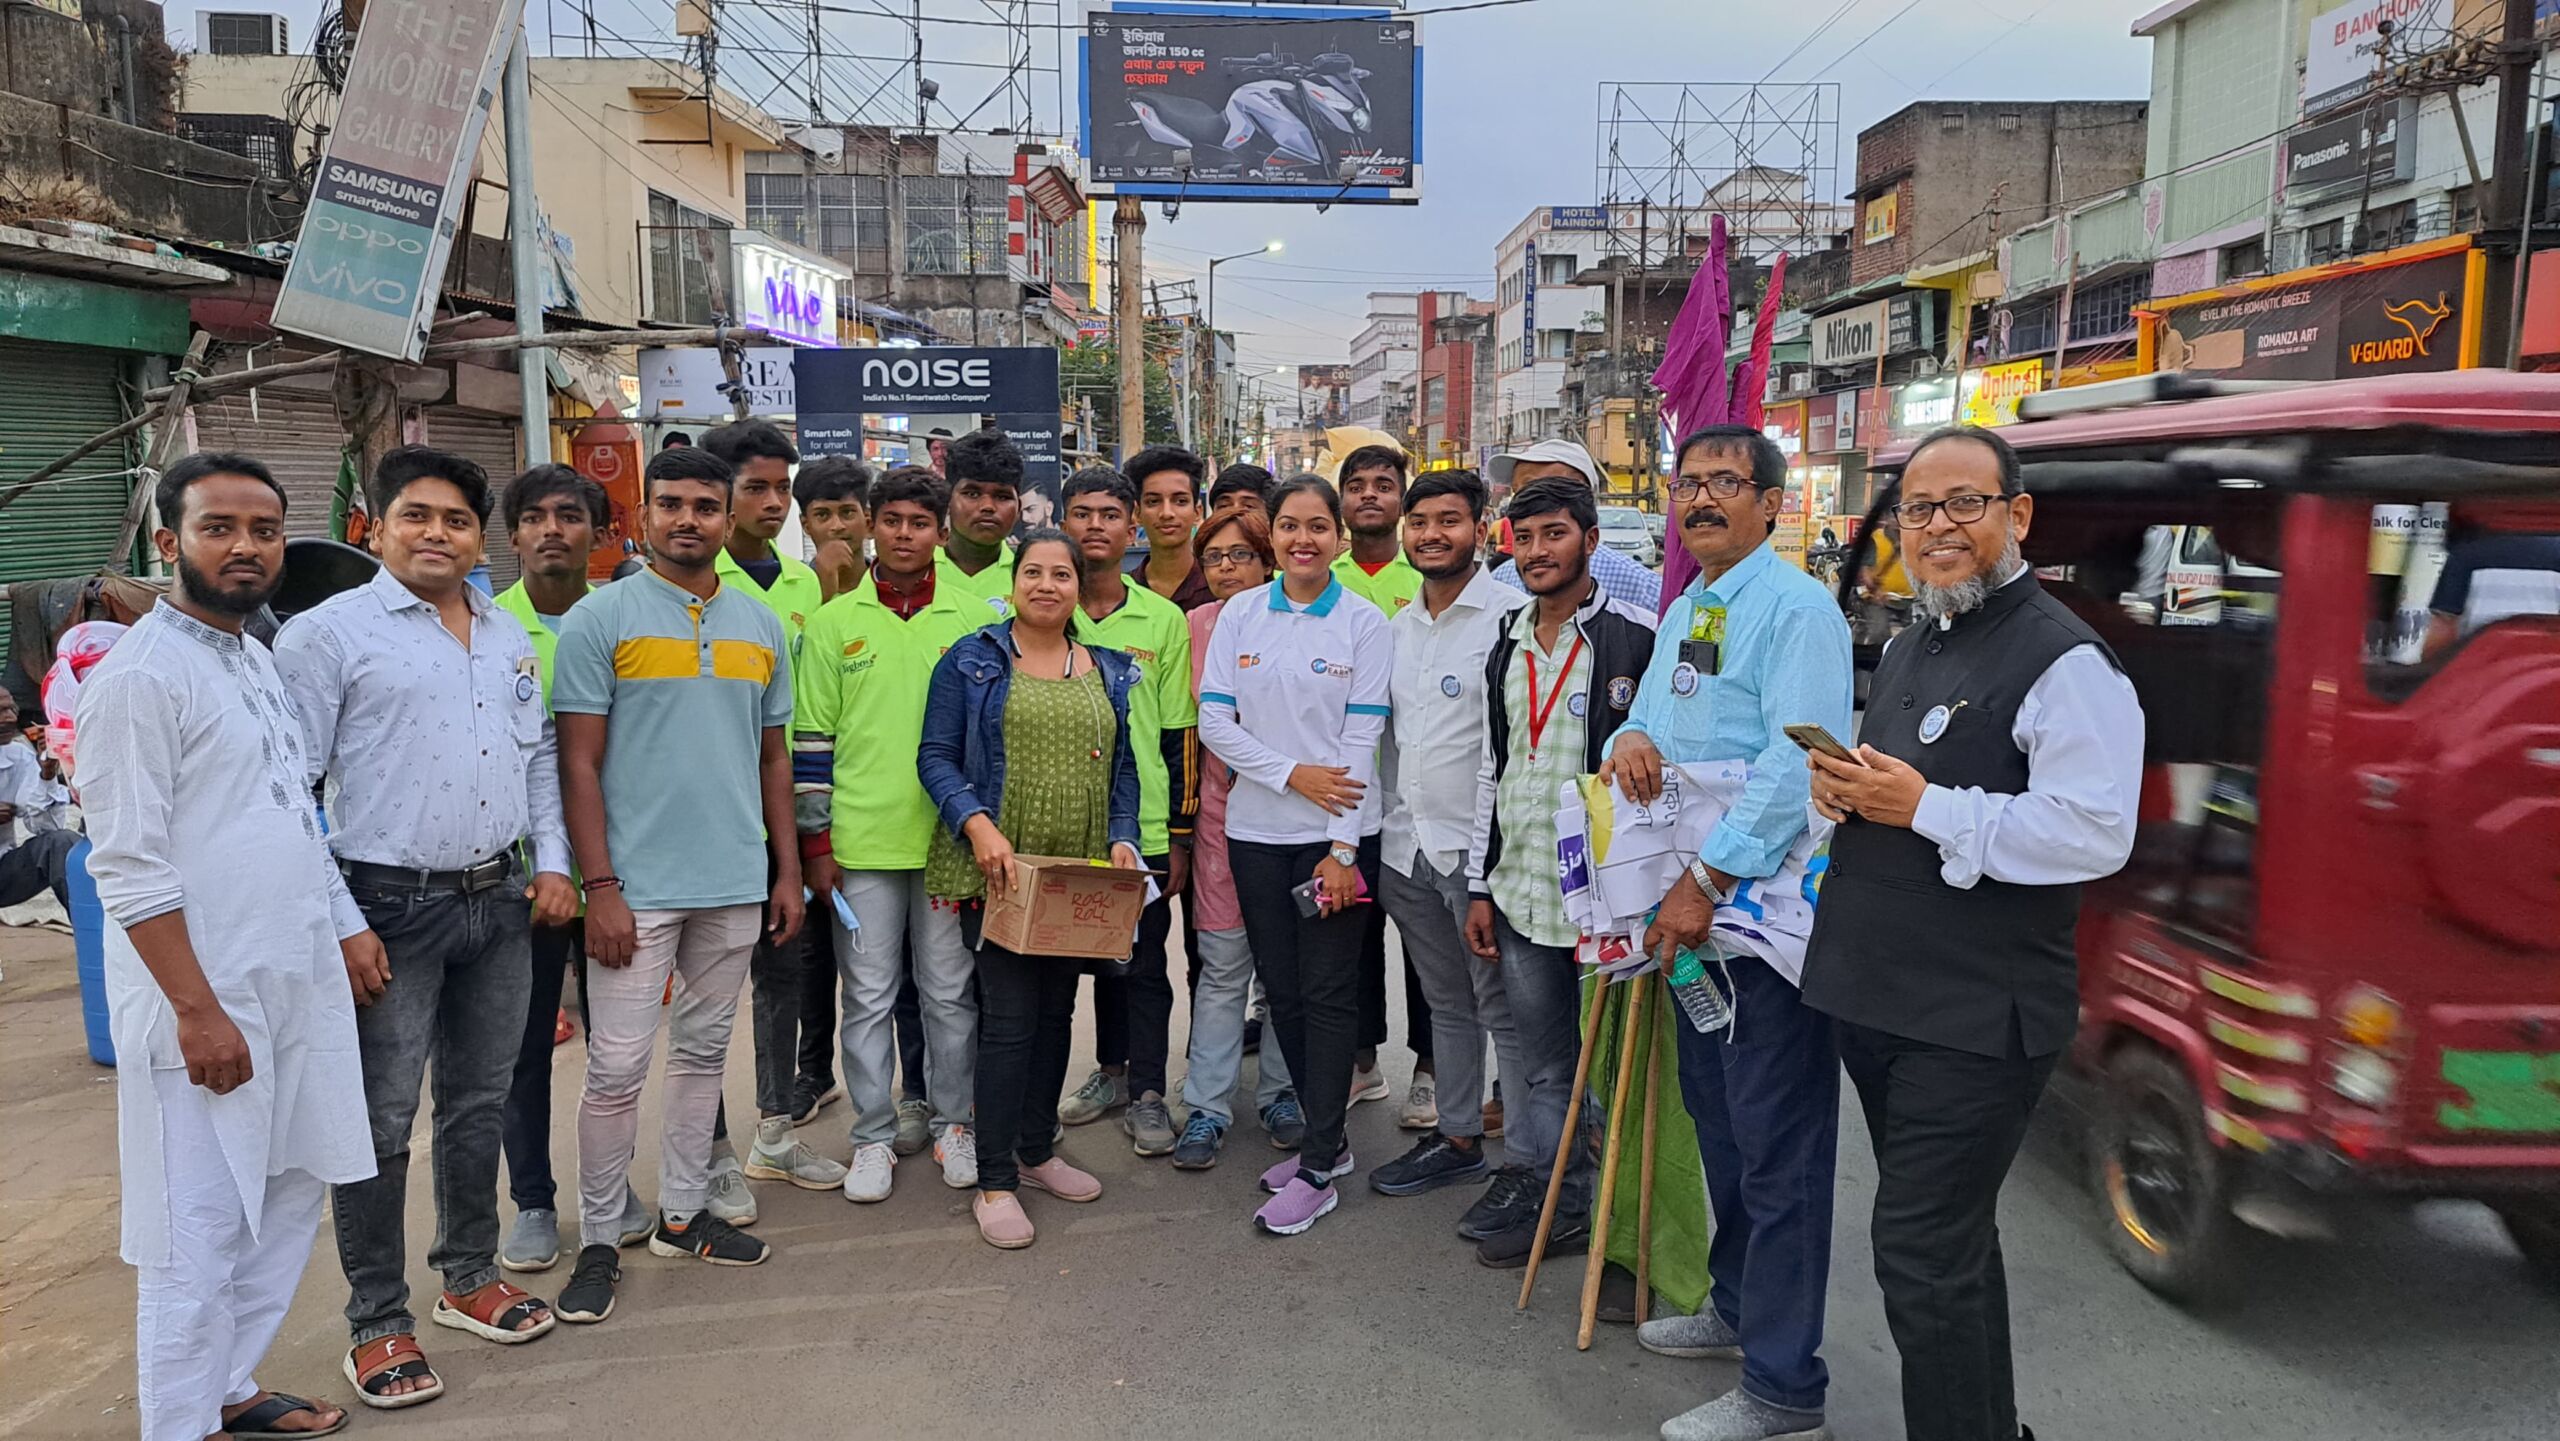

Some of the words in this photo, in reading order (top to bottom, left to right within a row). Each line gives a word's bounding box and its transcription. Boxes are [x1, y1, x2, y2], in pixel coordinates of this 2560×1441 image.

[1169, 46, 1190, 57] 150
[1191, 48, 1205, 57] cc
[365, 50, 474, 112] MOBILE
[2324, 85, 2363, 107] ELECTRICALS
[344, 106, 455, 164] GALLERY
[2294, 139, 2350, 171] Panasonic
[329, 165, 438, 207] SAMSUNG
[335, 189, 420, 220] smartphone
[1562, 208, 1599, 217] HOTEL
[1554, 218, 1606, 227] RAINBOW
[1527, 248, 1535, 295] HOTEL
[2200, 308, 2219, 321] REVEL
[2220, 307, 2229, 318] IN
[2230, 305, 2243, 317] THE
[2244, 296, 2280, 314] ROMANTIC
[2282, 290, 2311, 308] BREEZE
[1525, 301, 1534, 366] RAINBOW
[1826, 318, 1872, 360] Nikon
[2258, 330, 2298, 349] ROMANZA
[2300, 327, 2318, 343] ART
[2351, 337, 2413, 364] V-GUARD
[1982, 364, 2037, 405] Optical
[906, 393, 951, 401] Smartwatch
[804, 429, 831, 438] Smart
[832, 429, 852, 438] tech
[1031, 430, 1052, 440] tech
[810, 440, 822, 449] for
[823, 441, 847, 450] smart
[2397, 516, 2416, 528] for
[1072, 891, 1110, 909] ROCK
[1073, 907, 1109, 923] ROLL
[385, 1339, 397, 1357] F
